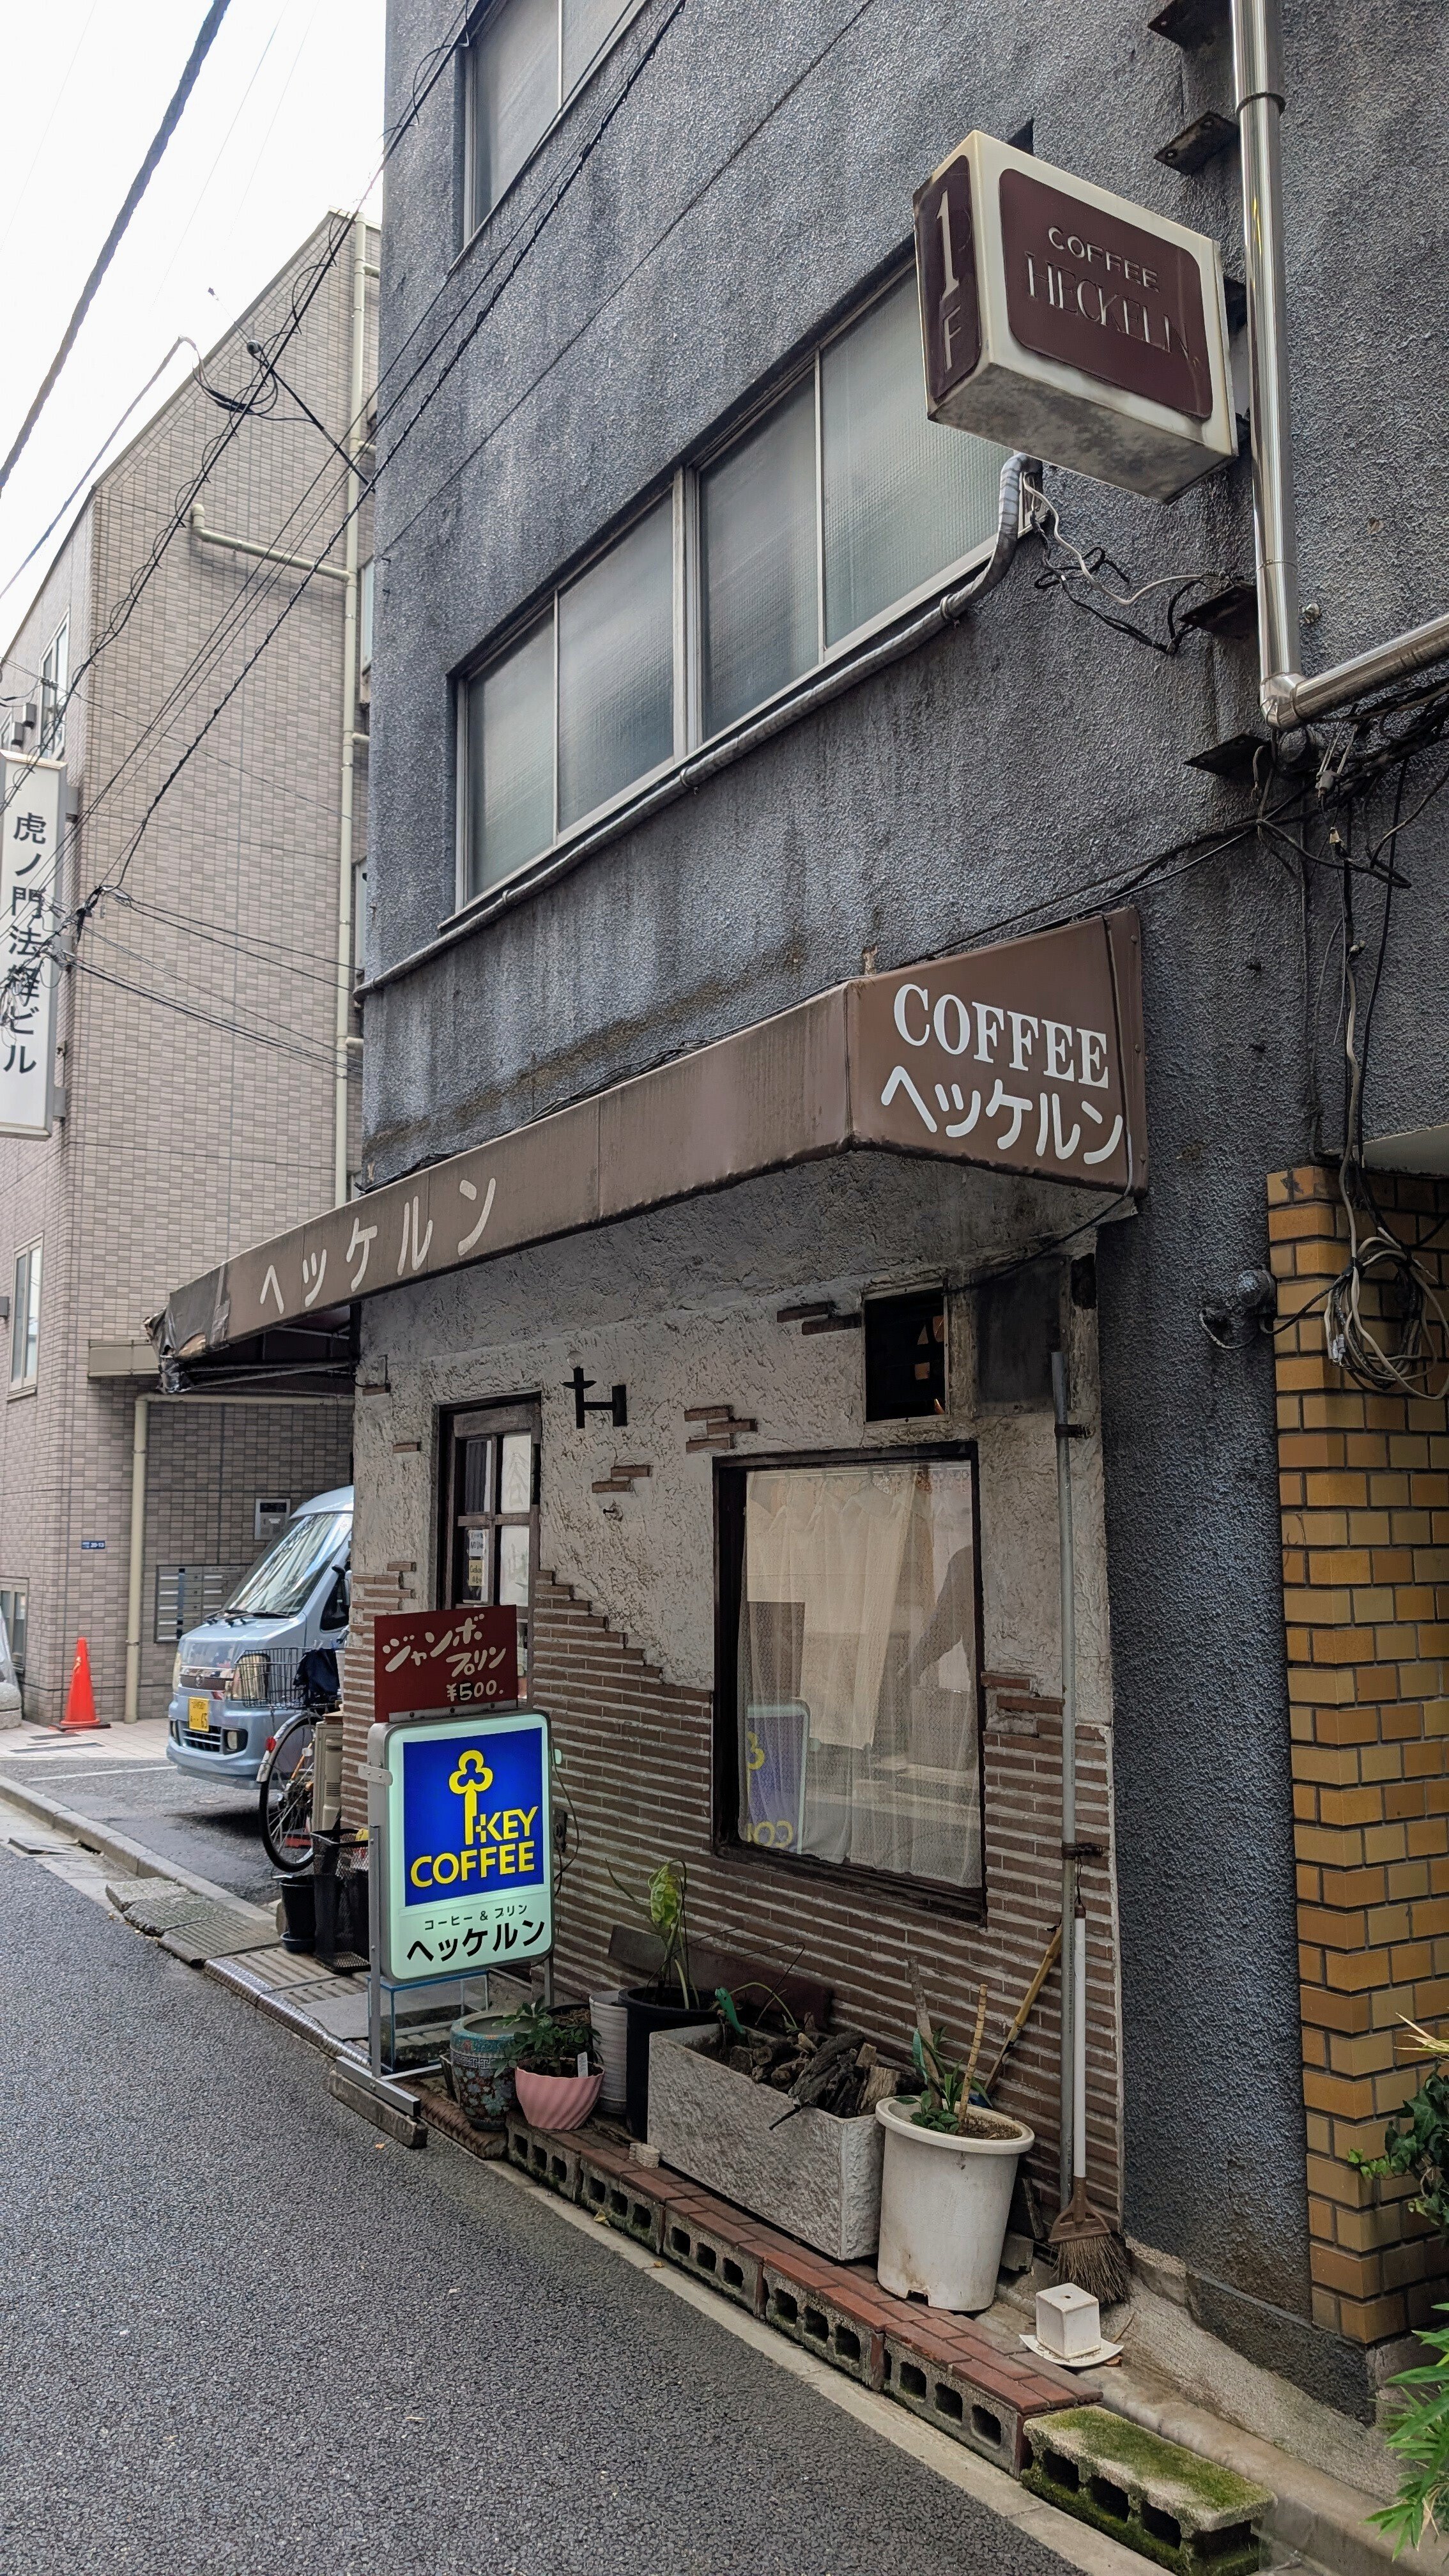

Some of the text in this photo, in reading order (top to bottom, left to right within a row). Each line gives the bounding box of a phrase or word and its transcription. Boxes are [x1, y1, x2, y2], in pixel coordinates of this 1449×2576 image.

[1048, 226, 1160, 293] COFFEE
[894, 983, 1109, 1089] COFFEE
[881, 1066, 1123, 1165] ヘッケルン
[259, 1177, 496, 1315] ヘッケルン
[382, 1613, 485, 1673] ジャンボ
[445, 1648, 507, 1678] プリン
[476, 1806, 539, 1843] KEY
[410, 1841, 535, 1888] COFFEE
[406, 1920, 545, 1963] ヘッケルン
[424, 1905, 528, 1931] コーヒー & プリン
